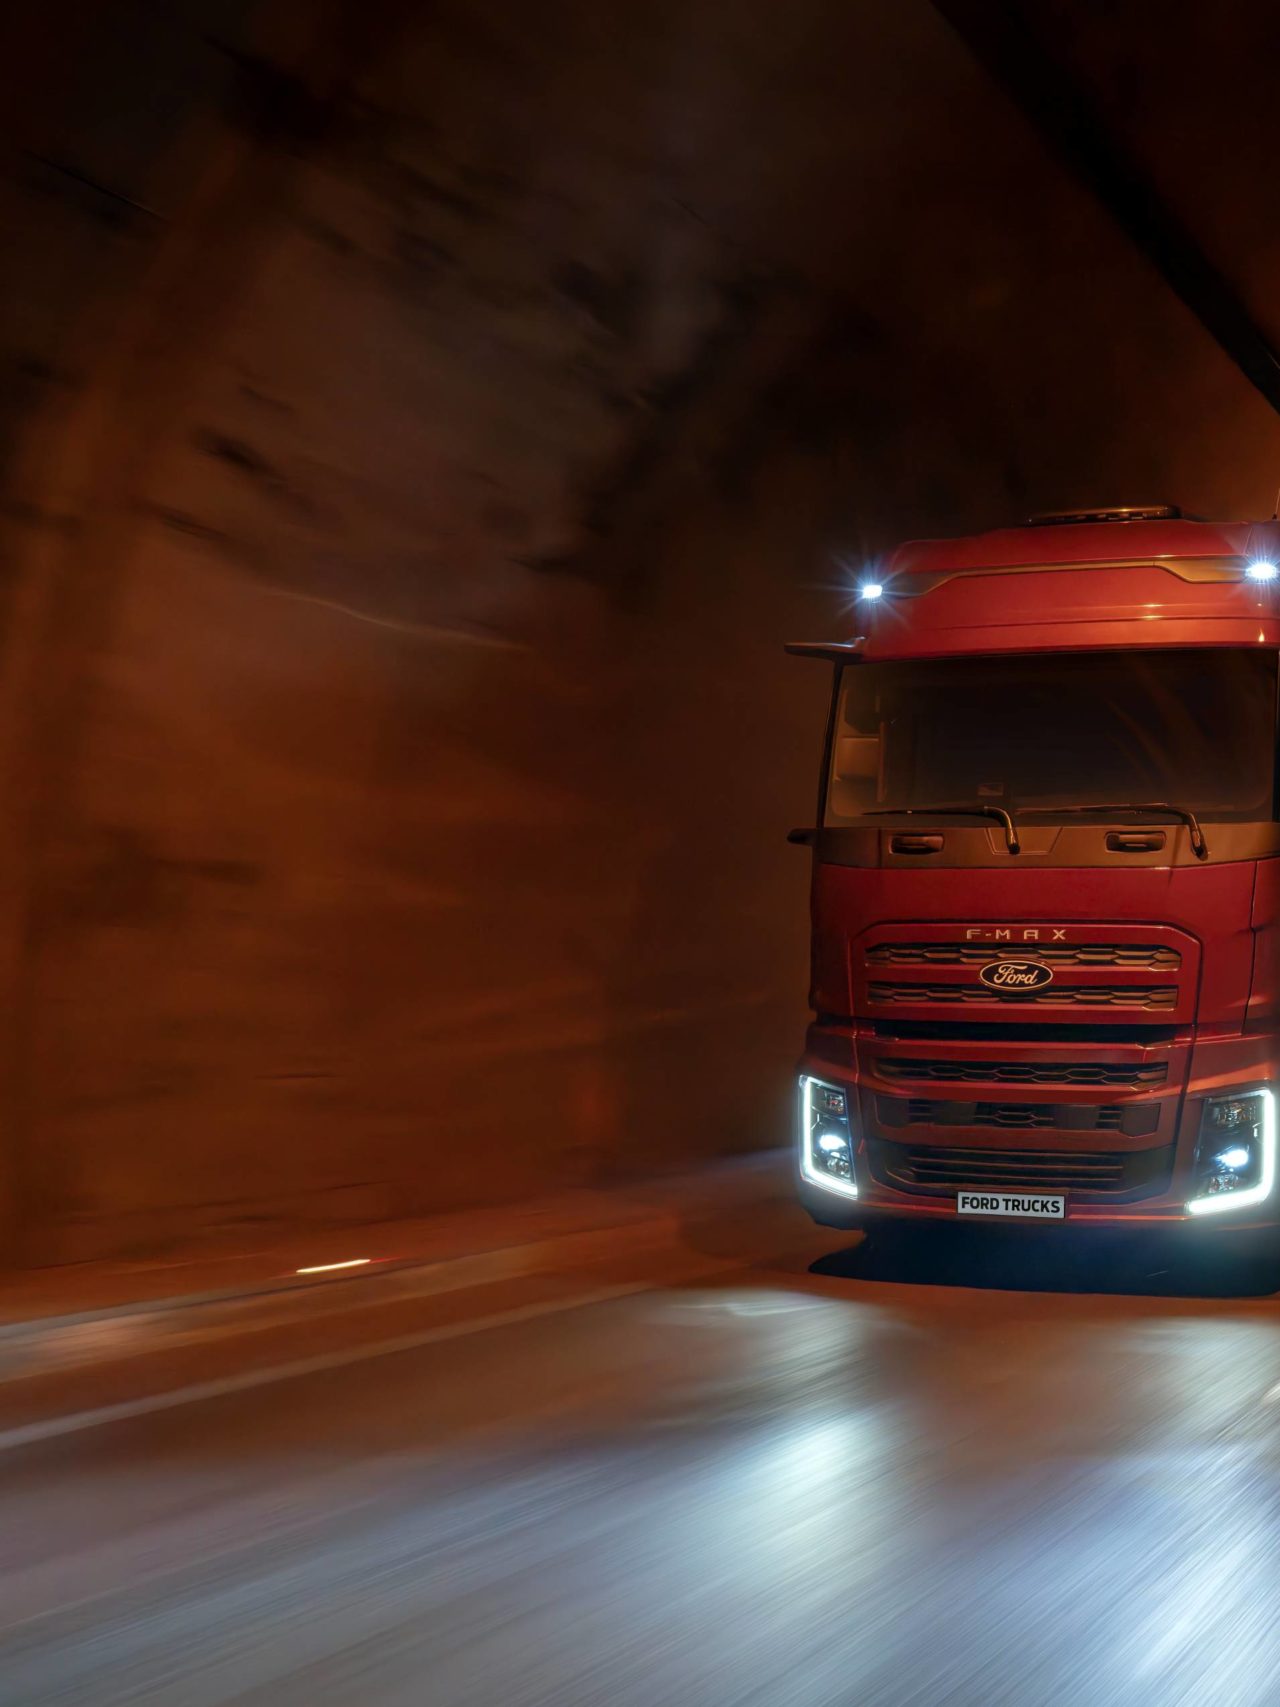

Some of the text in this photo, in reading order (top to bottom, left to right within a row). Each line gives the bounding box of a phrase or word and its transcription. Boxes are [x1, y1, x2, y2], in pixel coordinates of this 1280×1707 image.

[966, 928, 1066, 940] F-MAX
[993, 964, 1039, 985] Ford
[961, 1196, 1061, 1214] FORD TRUCKS
